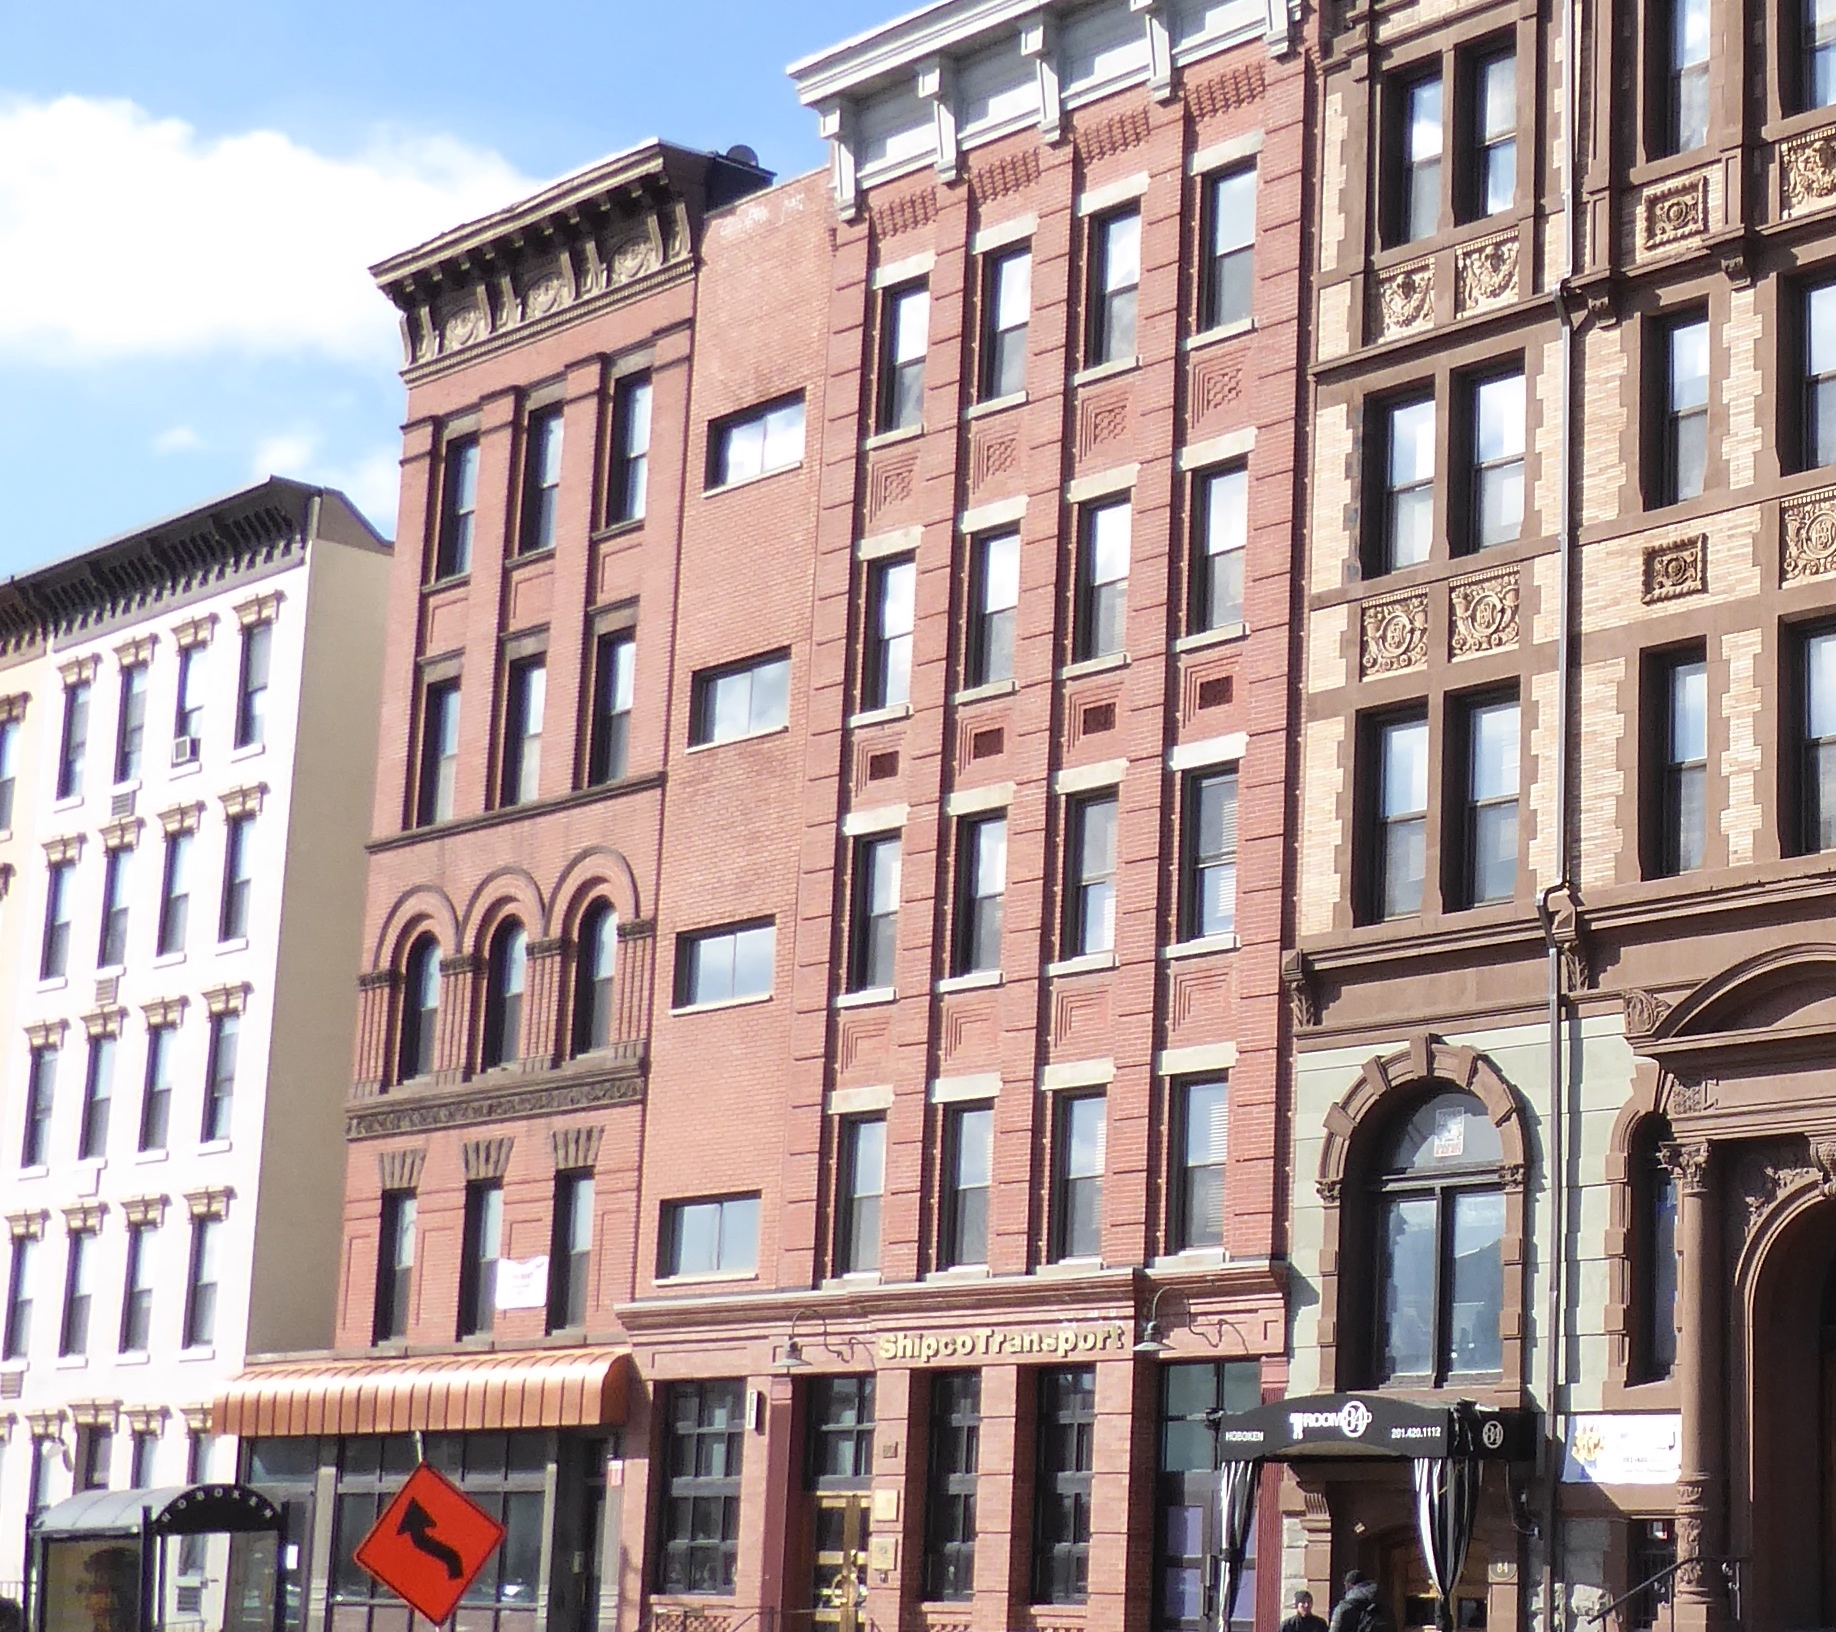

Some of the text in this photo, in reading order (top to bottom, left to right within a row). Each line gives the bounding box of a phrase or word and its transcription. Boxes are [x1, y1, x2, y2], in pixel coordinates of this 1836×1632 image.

[1303, 1413, 1342, 1427] ROOM
[1225, 1431, 1264, 1442] HOBOKEN
[1391, 1426, 1441, 1439] 201.420.1112
